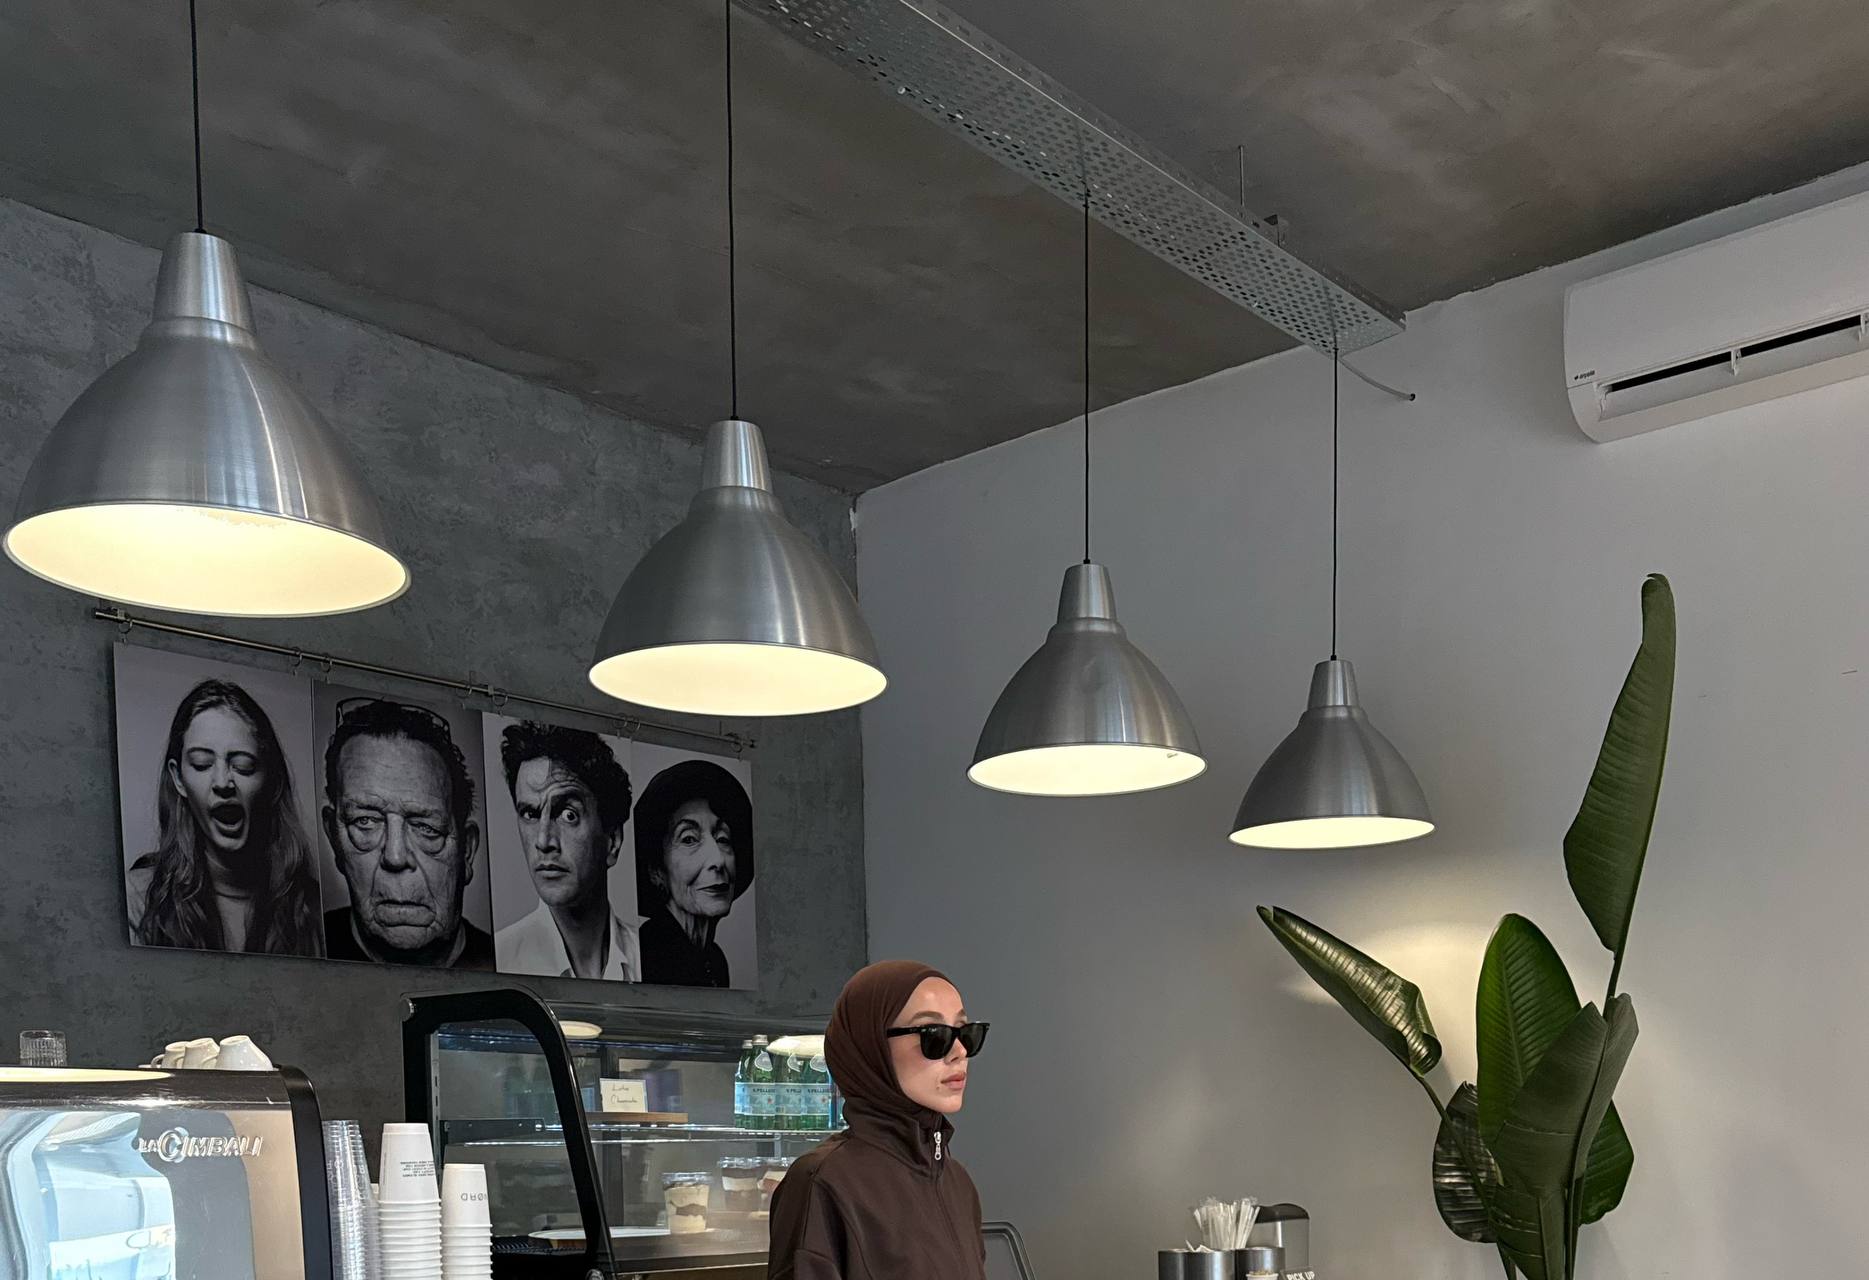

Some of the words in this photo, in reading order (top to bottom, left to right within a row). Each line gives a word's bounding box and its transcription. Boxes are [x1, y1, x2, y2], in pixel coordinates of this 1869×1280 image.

[138, 1138, 159, 1153] LA
[158, 1127, 263, 1163] CIMBALI
[1304, 1271, 1315, 1280] UP
